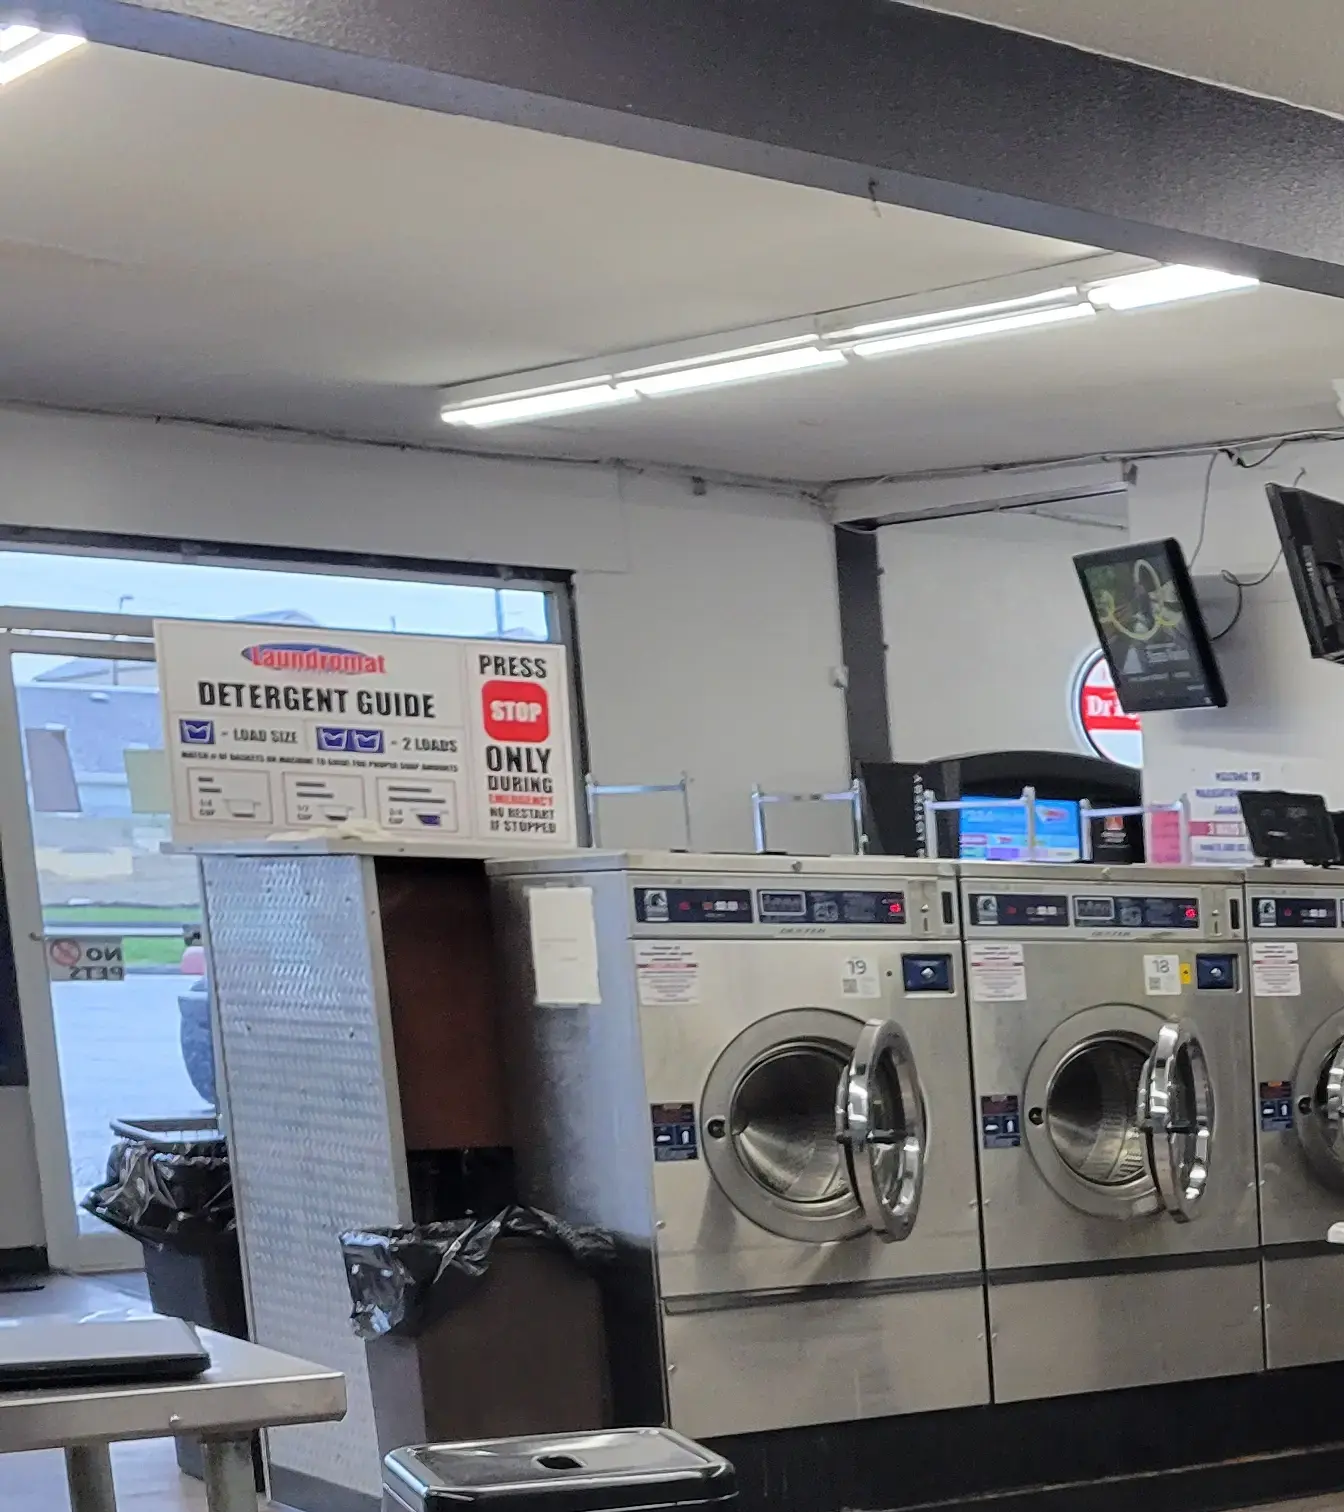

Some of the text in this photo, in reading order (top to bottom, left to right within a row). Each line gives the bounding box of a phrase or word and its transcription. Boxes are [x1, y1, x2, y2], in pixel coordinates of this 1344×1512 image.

[251, 645, 387, 674] Laundromat
[478, 654, 547, 678] PRESS
[198, 681, 437, 718] DETERGENT GUIDE
[490, 700, 543, 723] STOP
[233, 727, 268, 743] LOAD
[270, 729, 299, 744] SIZE
[402, 737, 411, 751] 2
[415, 737, 458, 753] LOADS
[486, 745, 552, 774] ONLY
[487, 775, 554, 793] DURING
[846, 959, 867, 975] 19
